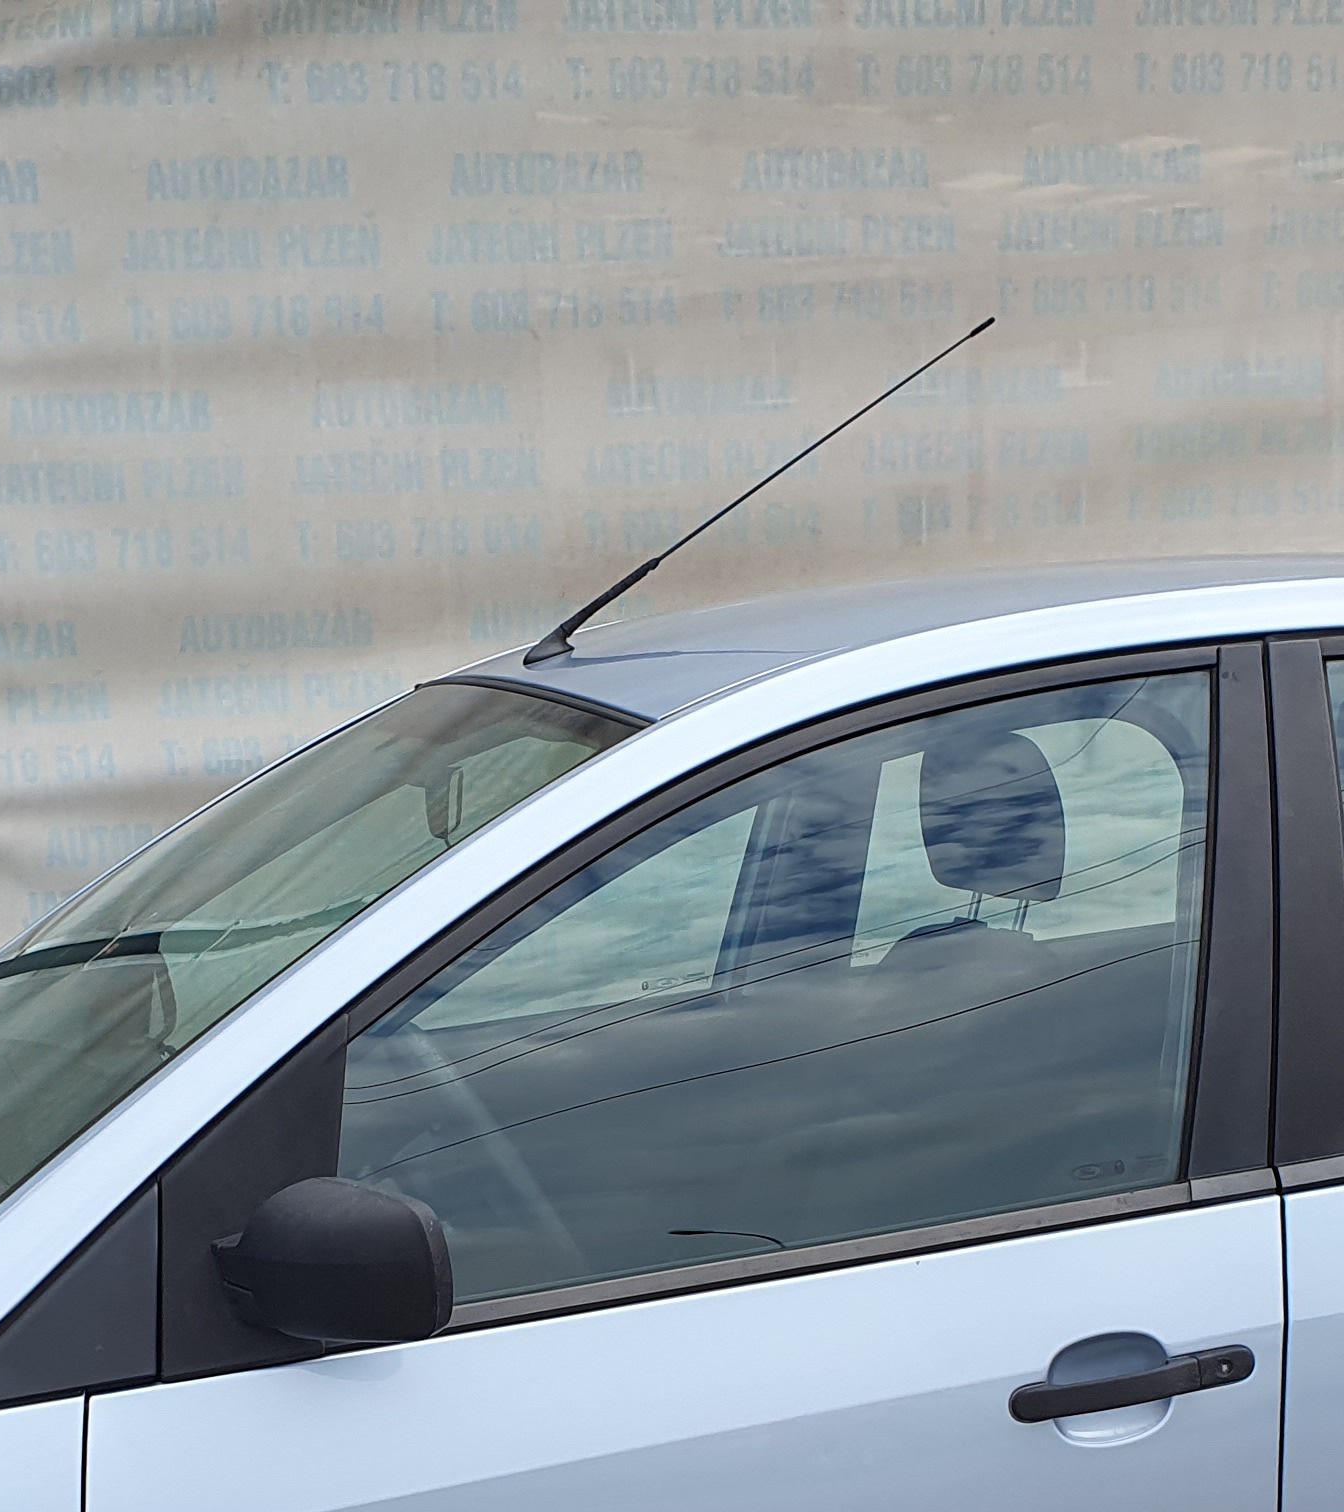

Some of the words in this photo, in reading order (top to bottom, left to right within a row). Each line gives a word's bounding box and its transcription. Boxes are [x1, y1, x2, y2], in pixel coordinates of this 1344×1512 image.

[146, 155, 349, 201] AUTOBAZAR
[450, 151, 644, 194] AUTOBAZAR
[738, 147, 929, 191] AUTOBAZAR
[9, 391, 212, 436] AUTOBAZAR
[177, 607, 375, 655] AUTOBAZAR
